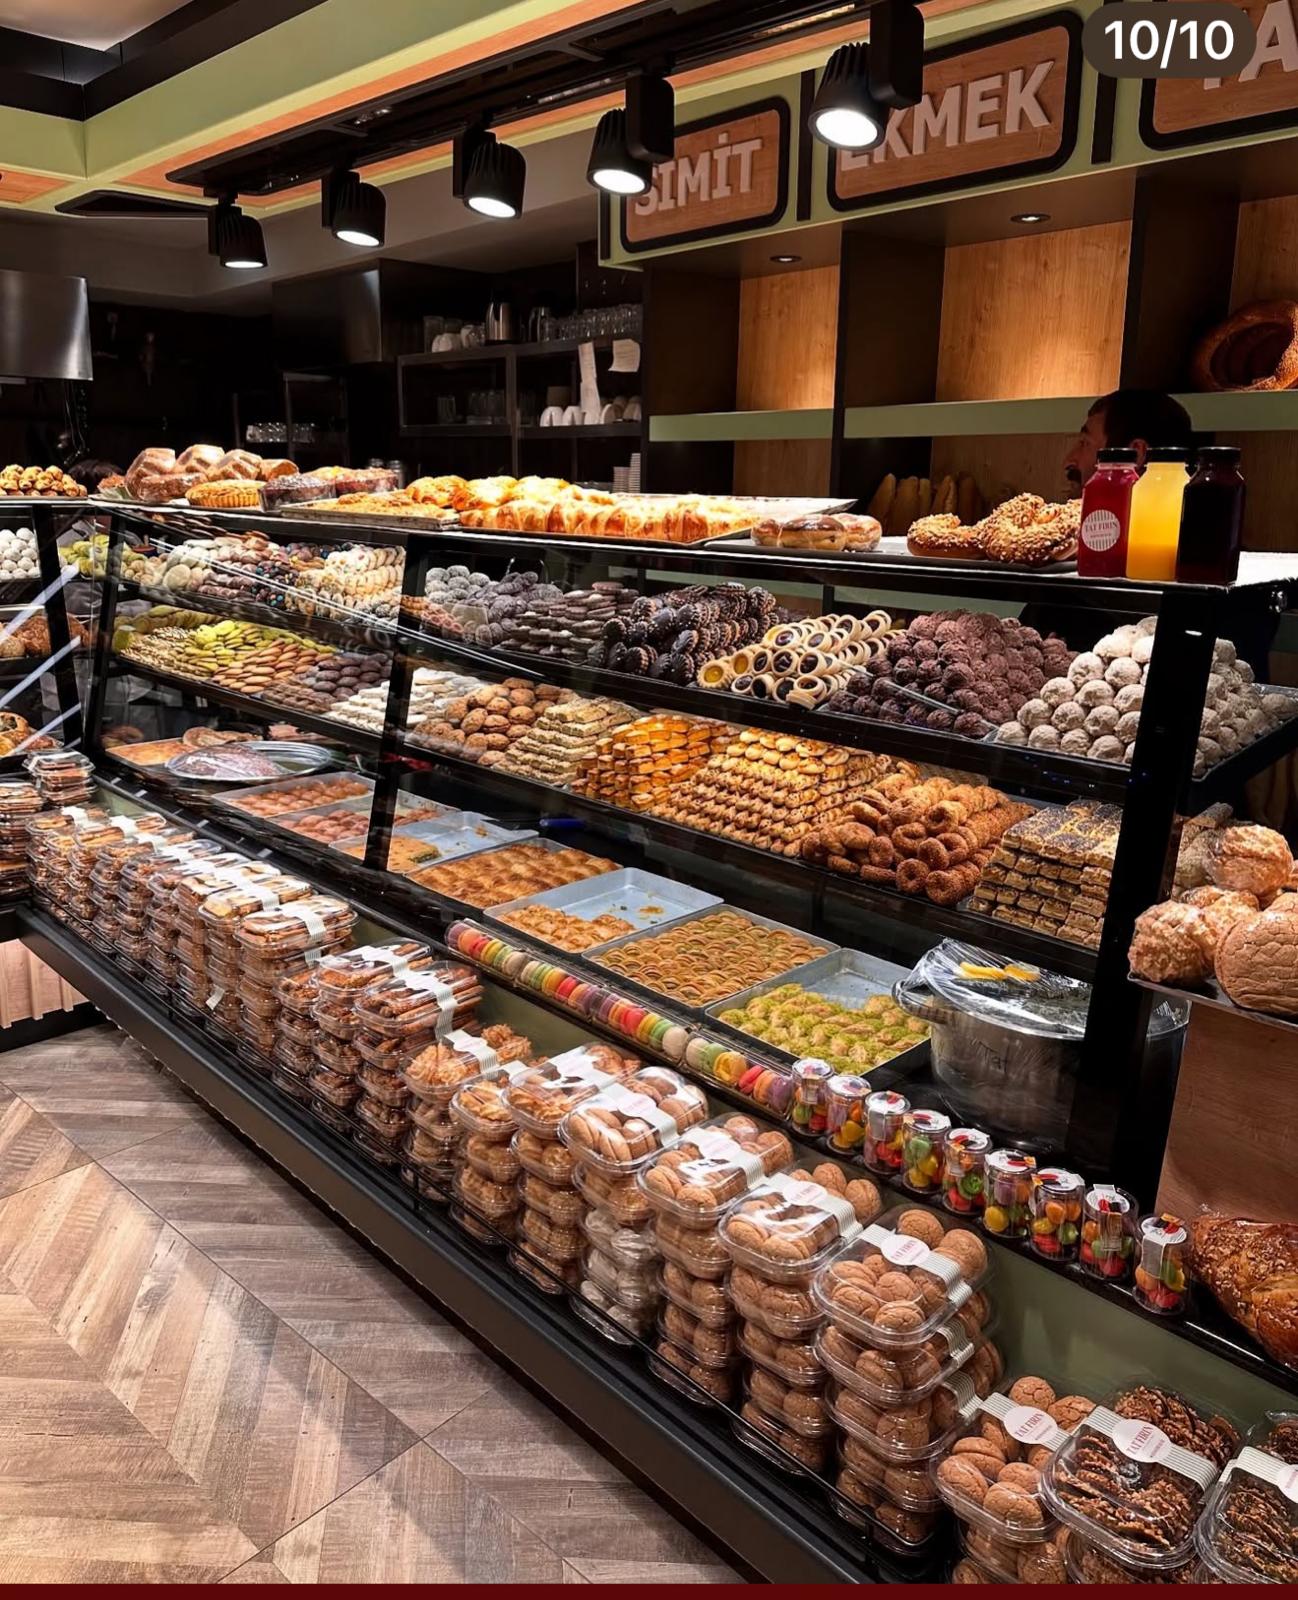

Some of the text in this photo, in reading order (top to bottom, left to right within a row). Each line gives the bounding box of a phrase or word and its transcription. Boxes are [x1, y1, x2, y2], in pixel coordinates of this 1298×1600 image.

[840, 60, 1055, 171] KMEK
[1126, 1425, 1154, 1455] TAT FIRIN
